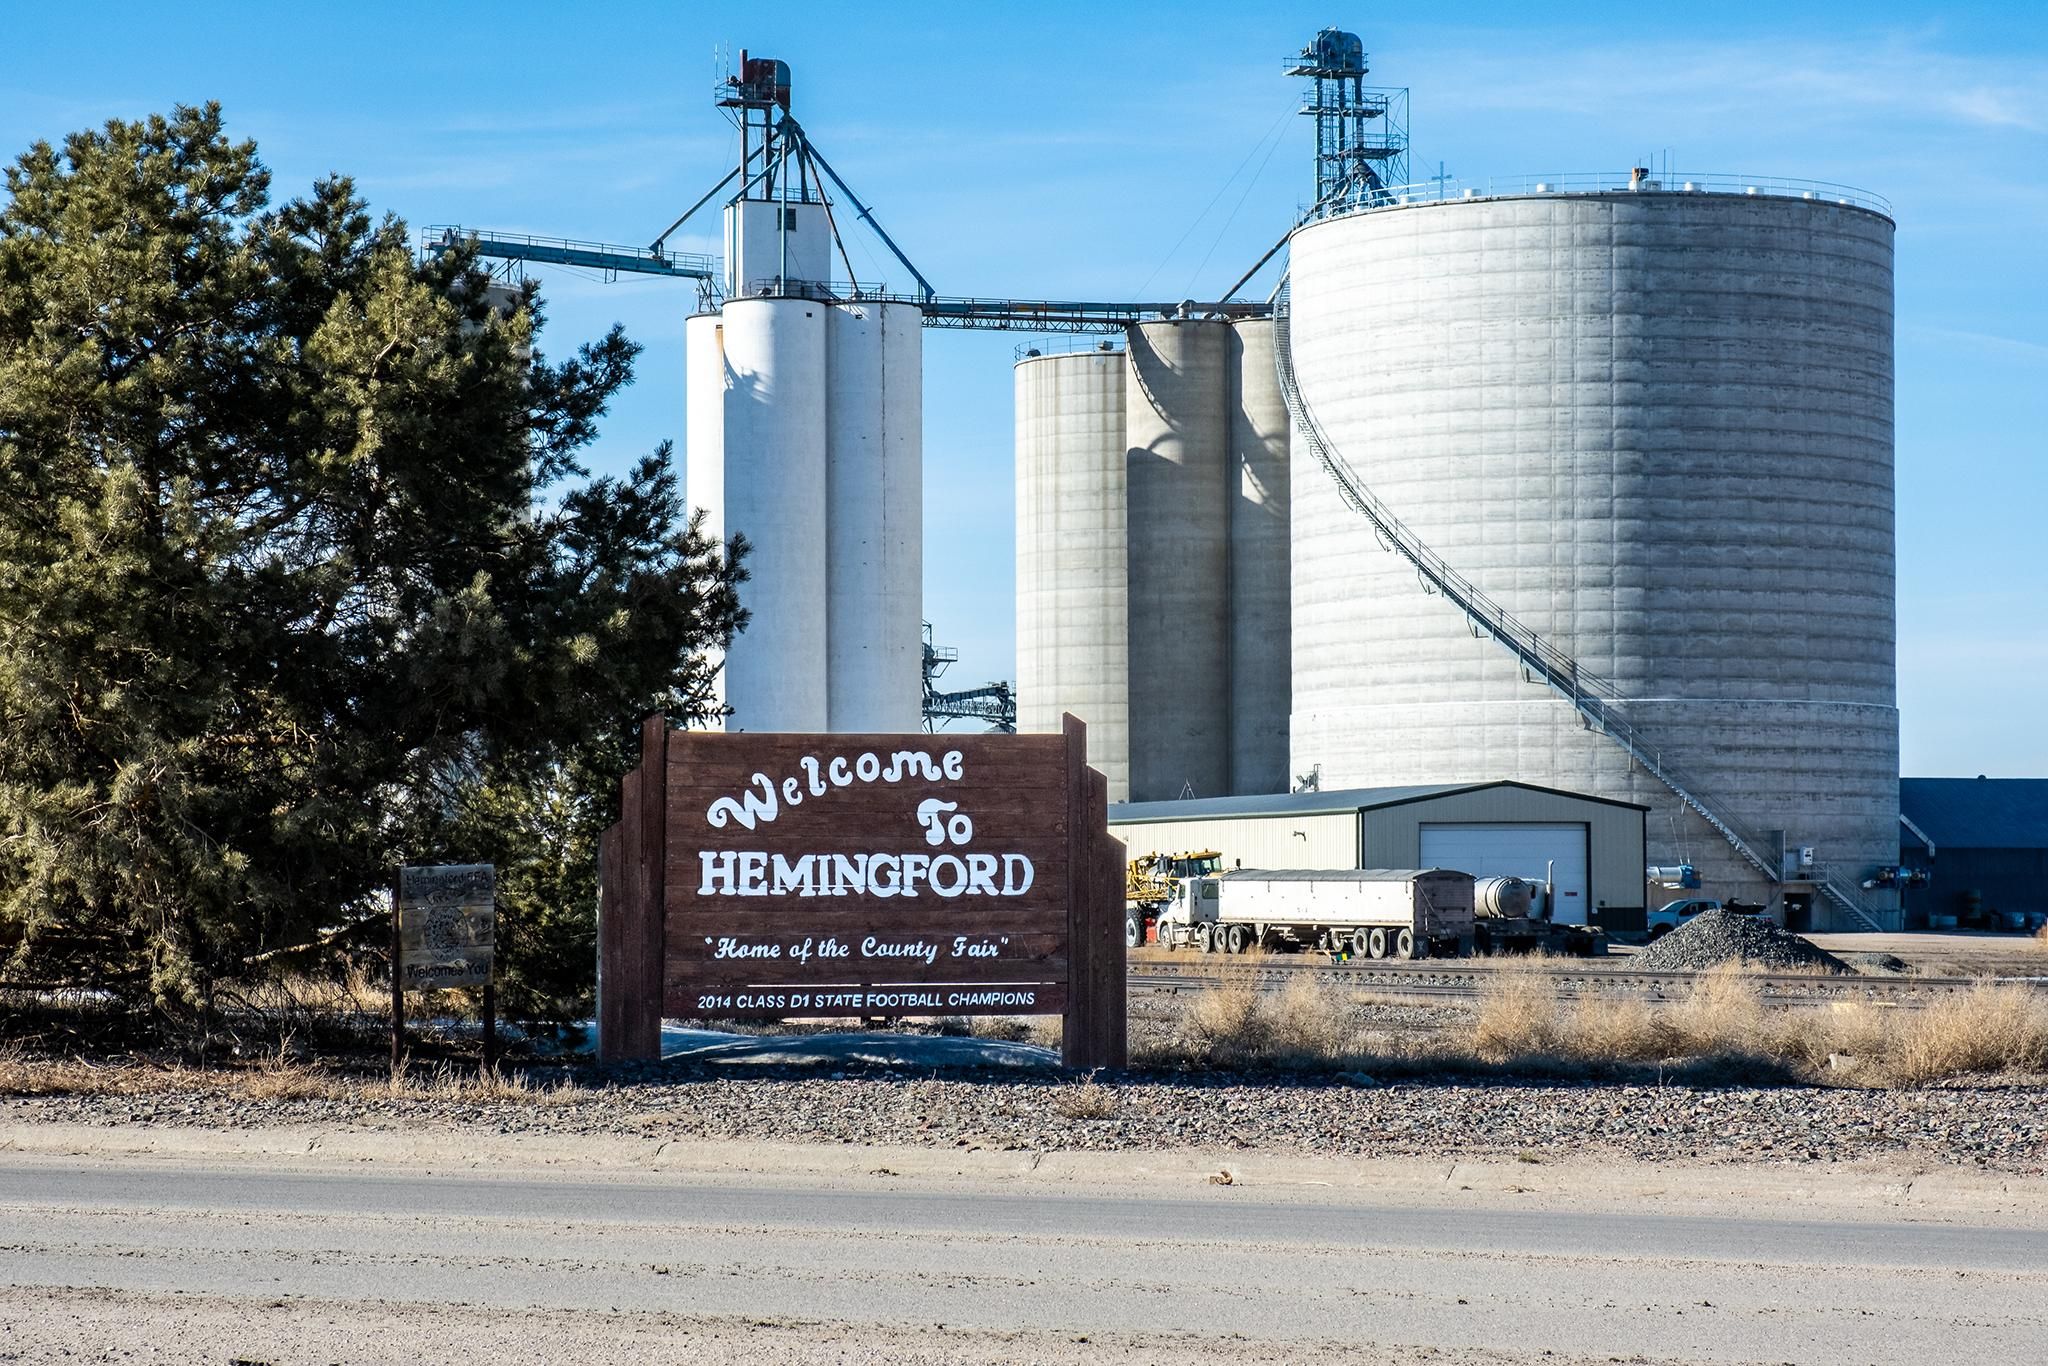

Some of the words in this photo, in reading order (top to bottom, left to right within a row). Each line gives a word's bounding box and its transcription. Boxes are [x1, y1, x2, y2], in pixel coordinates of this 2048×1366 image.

[706, 750, 964, 830] Welcome
[916, 798, 973, 846] To
[696, 850, 1035, 898] HEMINGFORD
[789, 937, 813, 965] of
[817, 937, 850, 958] the
[860, 936, 938, 965] County
[407, 964, 464, 979] Welcomes
[466, 962, 489, 976] You
[697, 995, 731, 1009] 2014
[736, 994, 786, 1009] CLASS
[790, 994, 810, 1008] D1
[814, 993, 863, 1008] STATE
[866, 993, 943, 1008] FOOTBALL
[948, 991, 1035, 1006] CHAMPIONS
